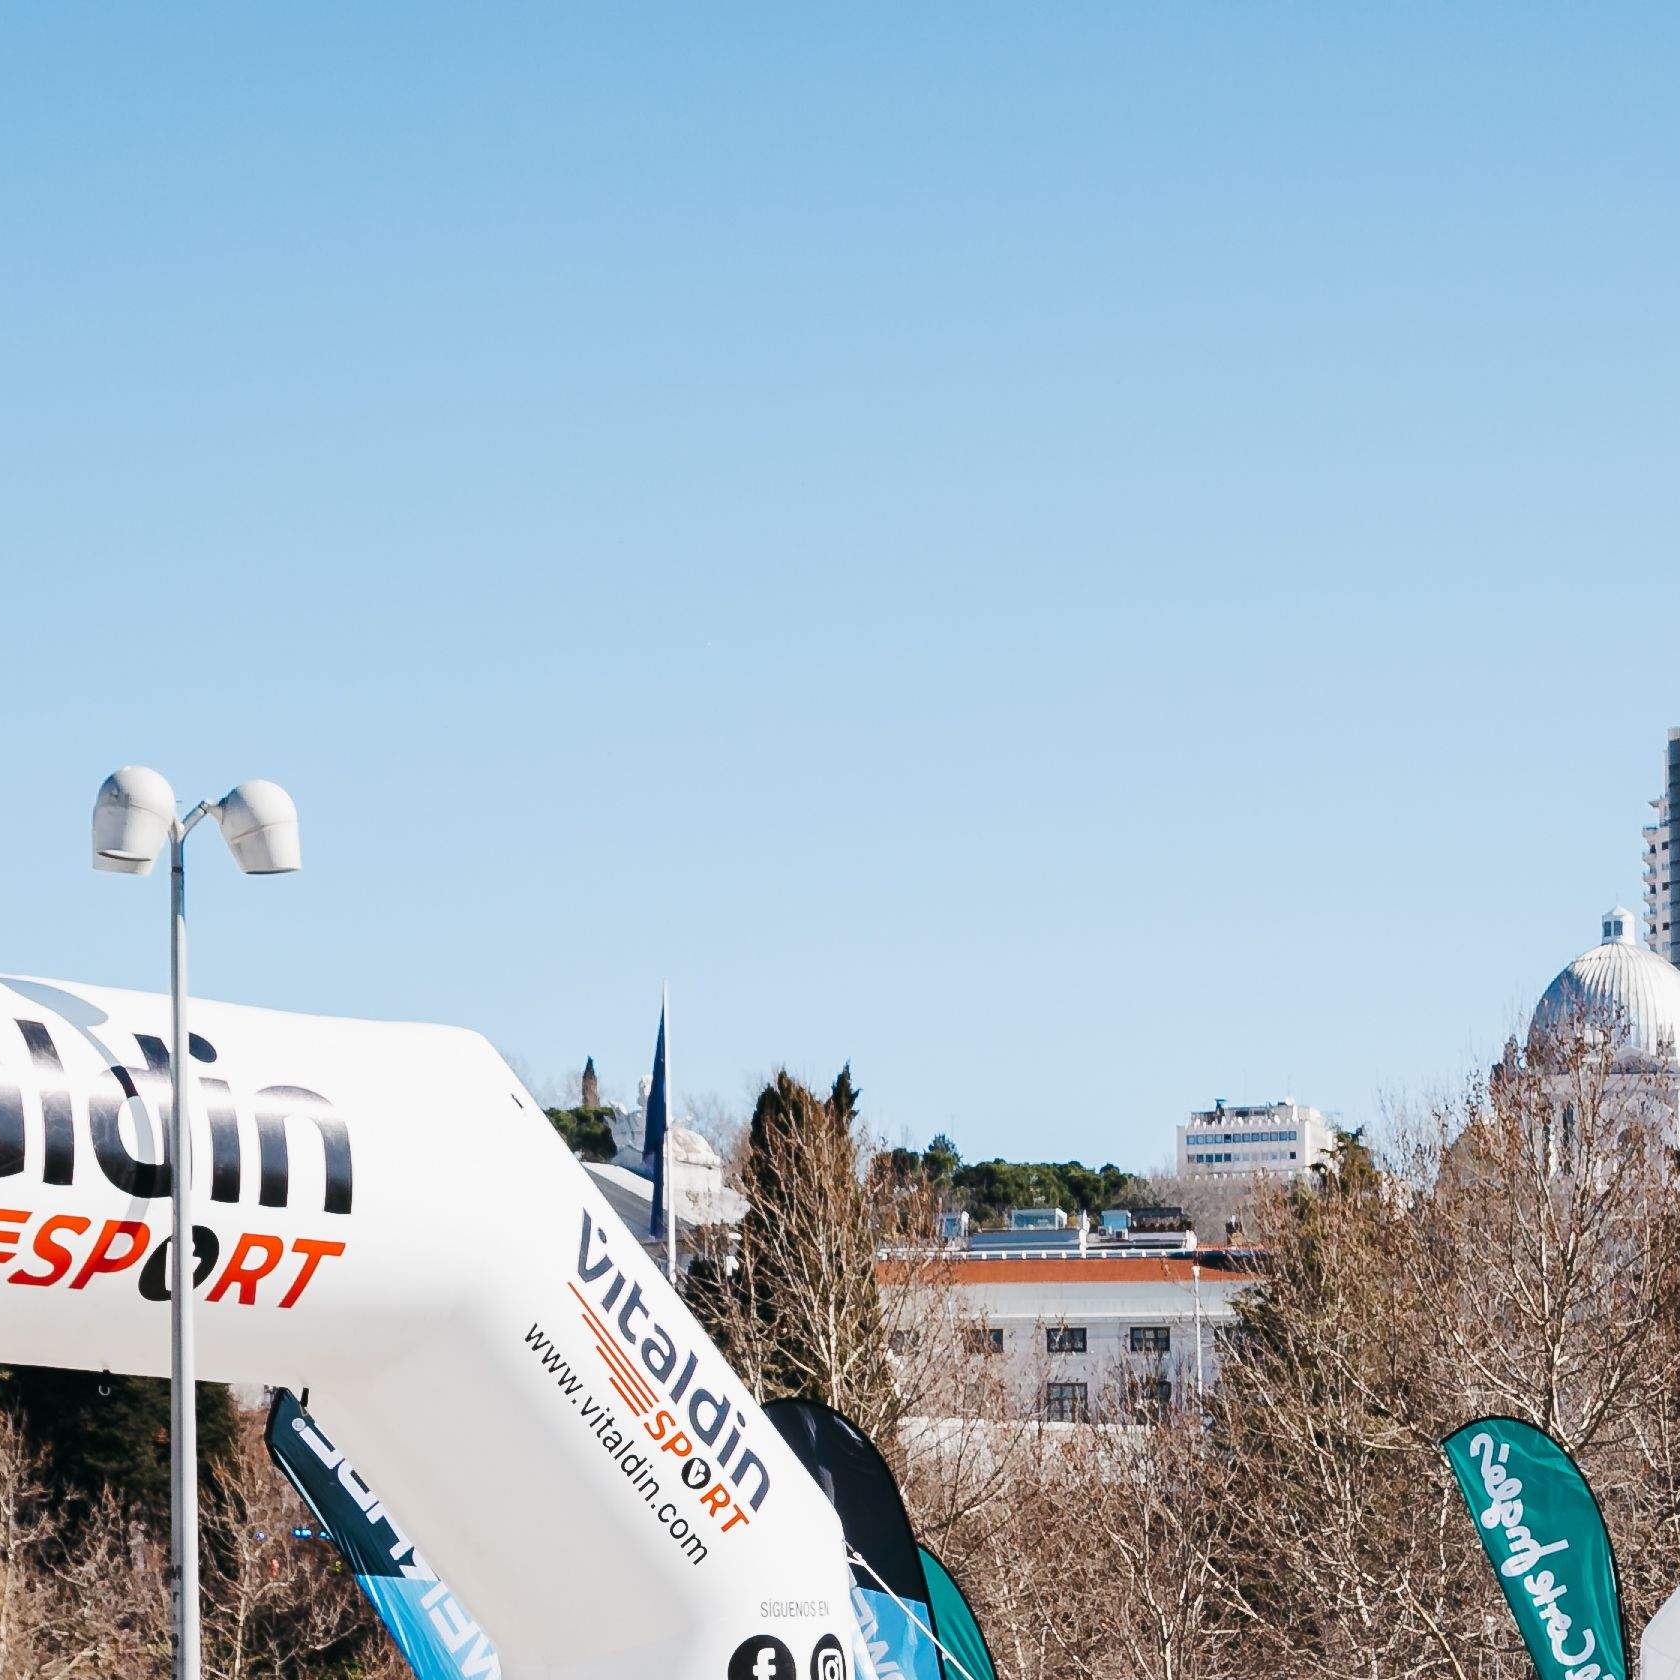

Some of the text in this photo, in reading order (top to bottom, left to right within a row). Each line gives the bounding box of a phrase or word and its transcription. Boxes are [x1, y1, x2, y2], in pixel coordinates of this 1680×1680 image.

[523, 1321, 709, 1566] www.vitaldin.com
[577, 1206, 771, 1513] vitaldin
[643, 1409, 750, 1534] SPORT
